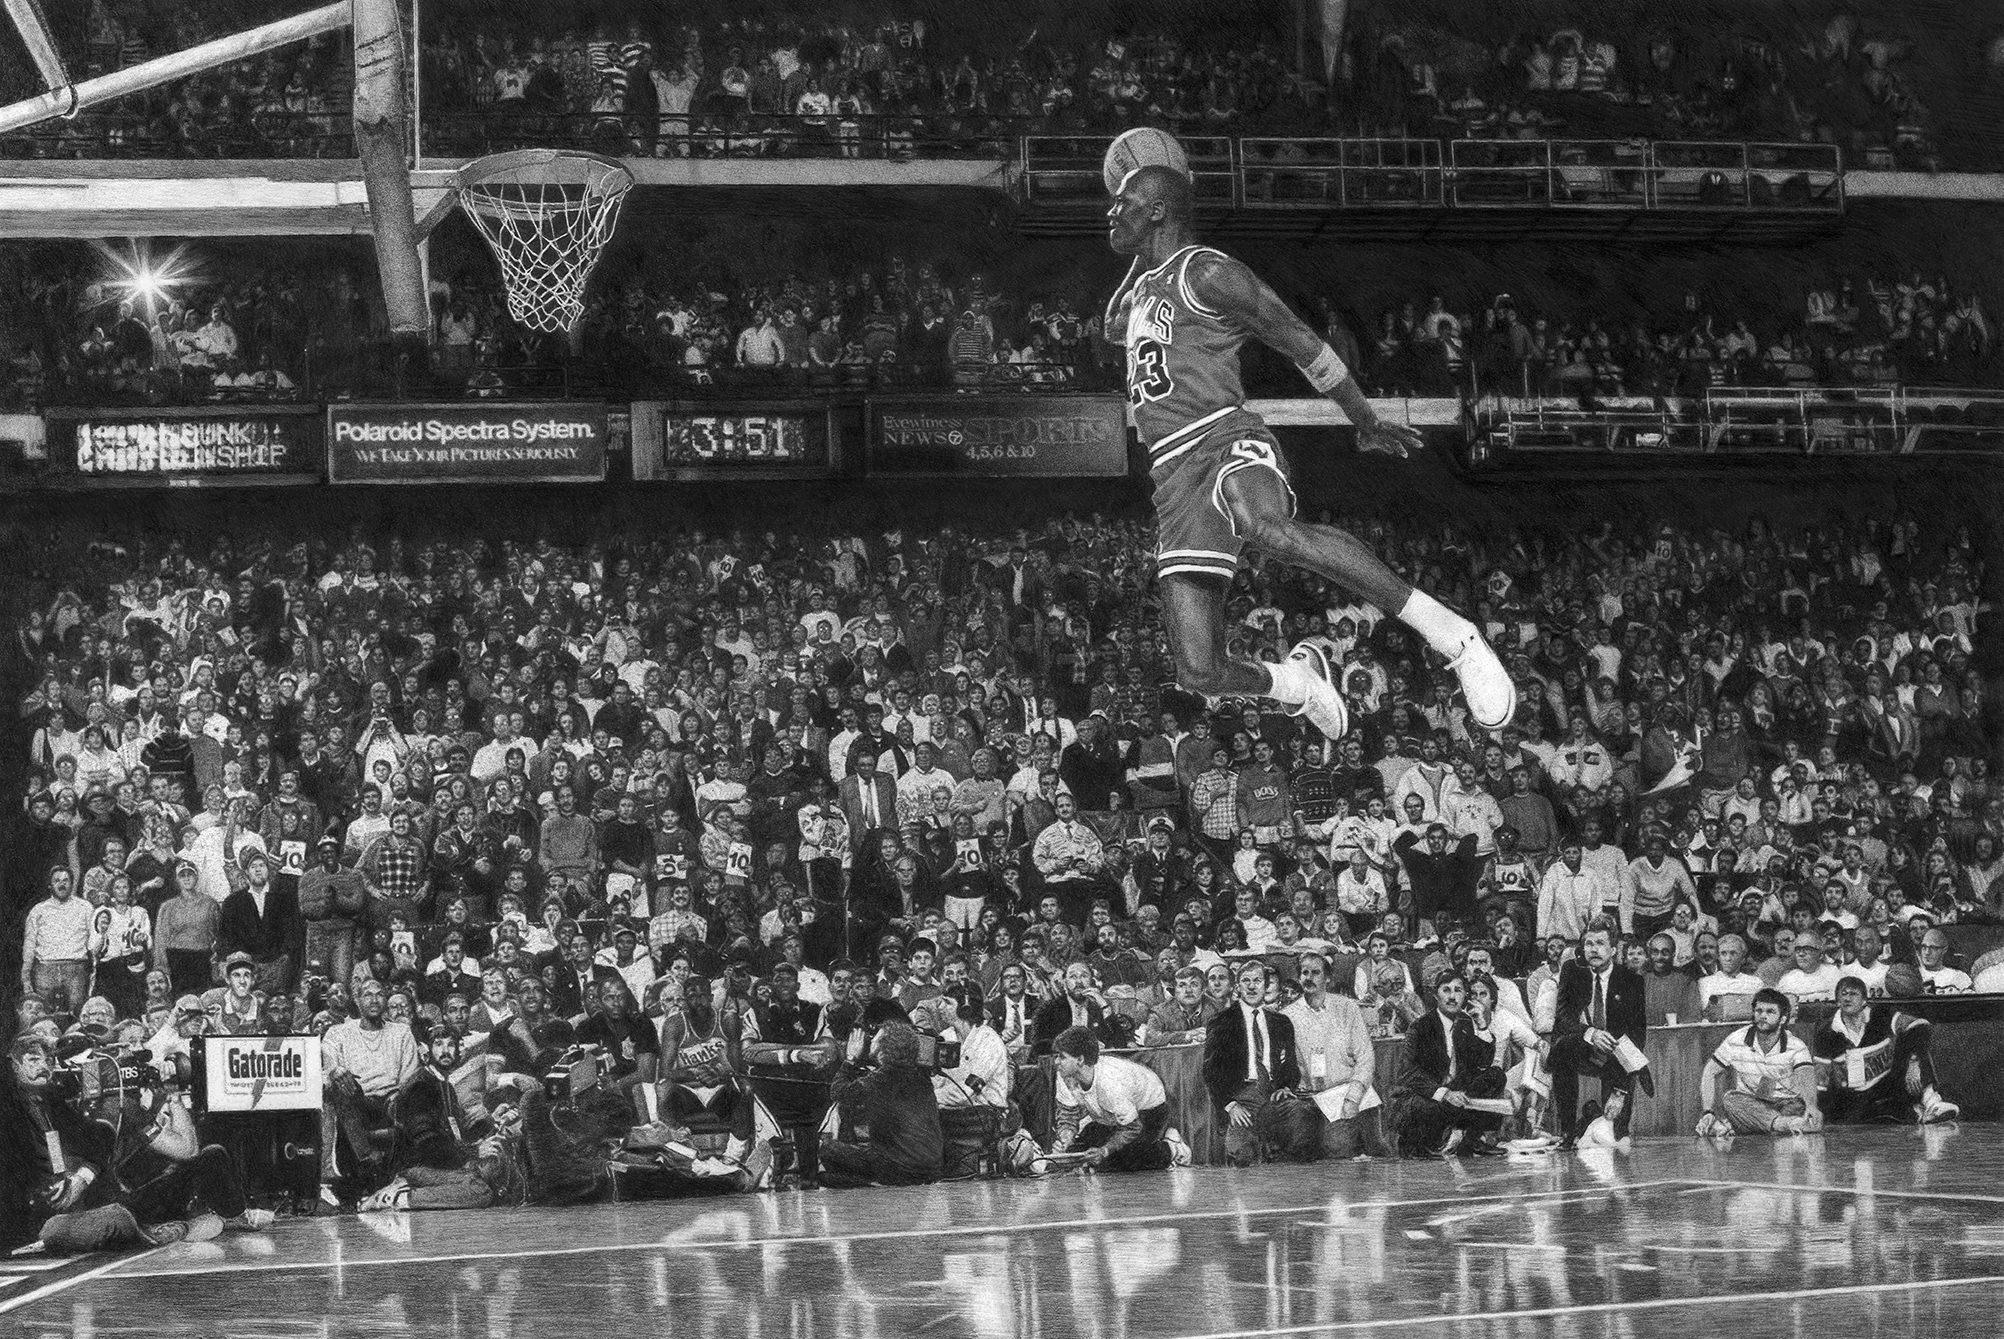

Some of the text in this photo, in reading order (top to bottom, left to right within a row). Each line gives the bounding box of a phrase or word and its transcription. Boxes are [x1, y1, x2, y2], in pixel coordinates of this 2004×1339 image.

[335, 418, 596, 445] Polaroid Spectra System.
[692, 416, 790, 458] 3:51
[884, 431, 948, 446] NEWS
[729, 851, 750, 871] 10
[228, 1047, 303, 1079] Gatorade
[678, 1039, 726, 1067] Hawks
